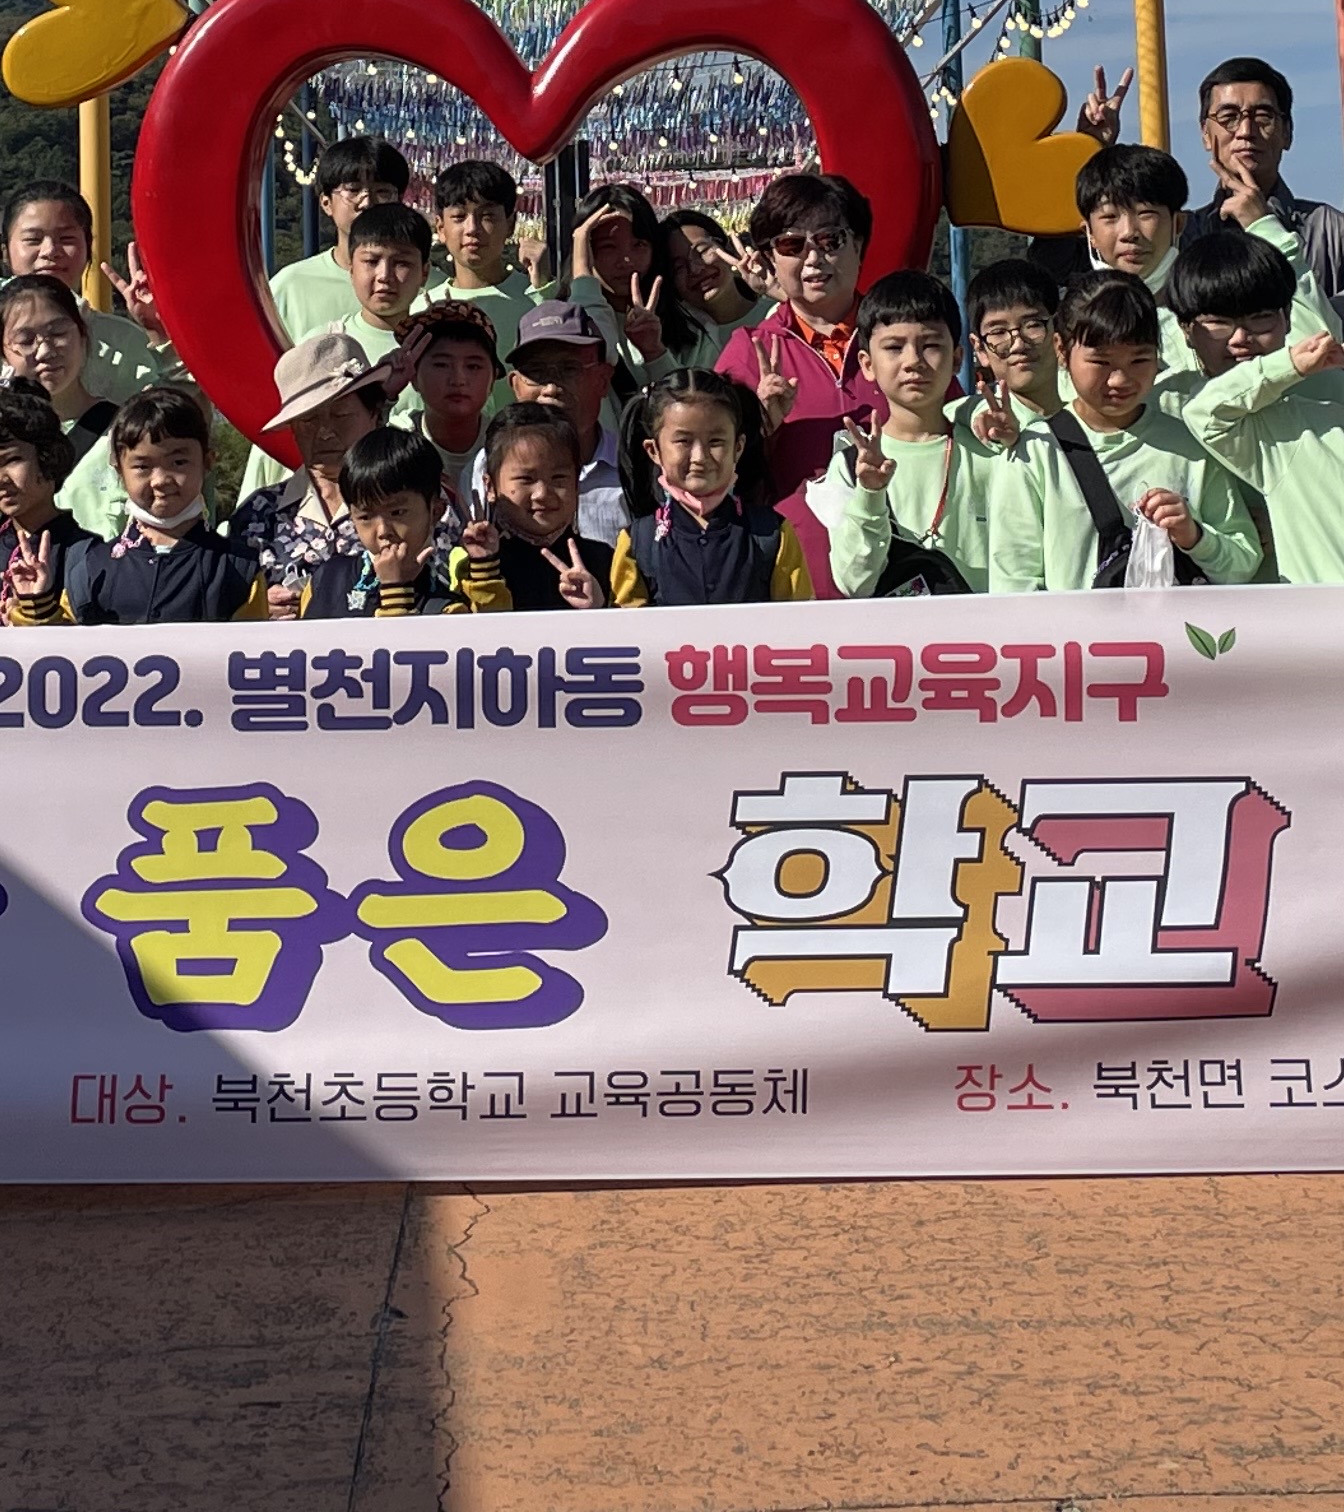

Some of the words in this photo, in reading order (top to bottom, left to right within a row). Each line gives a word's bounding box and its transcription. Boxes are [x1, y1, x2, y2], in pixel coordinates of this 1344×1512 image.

[227, 647, 646, 732] 별천지하동
[664, 640, 1170, 728] 행복교육지구
[81, 778, 610, 1031] 품은
[708, 770, 1292, 1032] 학교
[69, 1072, 187, 1126] 대상.
[211, 1070, 528, 1124] 북천초등학교
[549, 1067, 810, 1118] 교육공동체
[953, 1062, 1071, 1113] 장소.
[1092, 1057, 1247, 1112] 북천면
